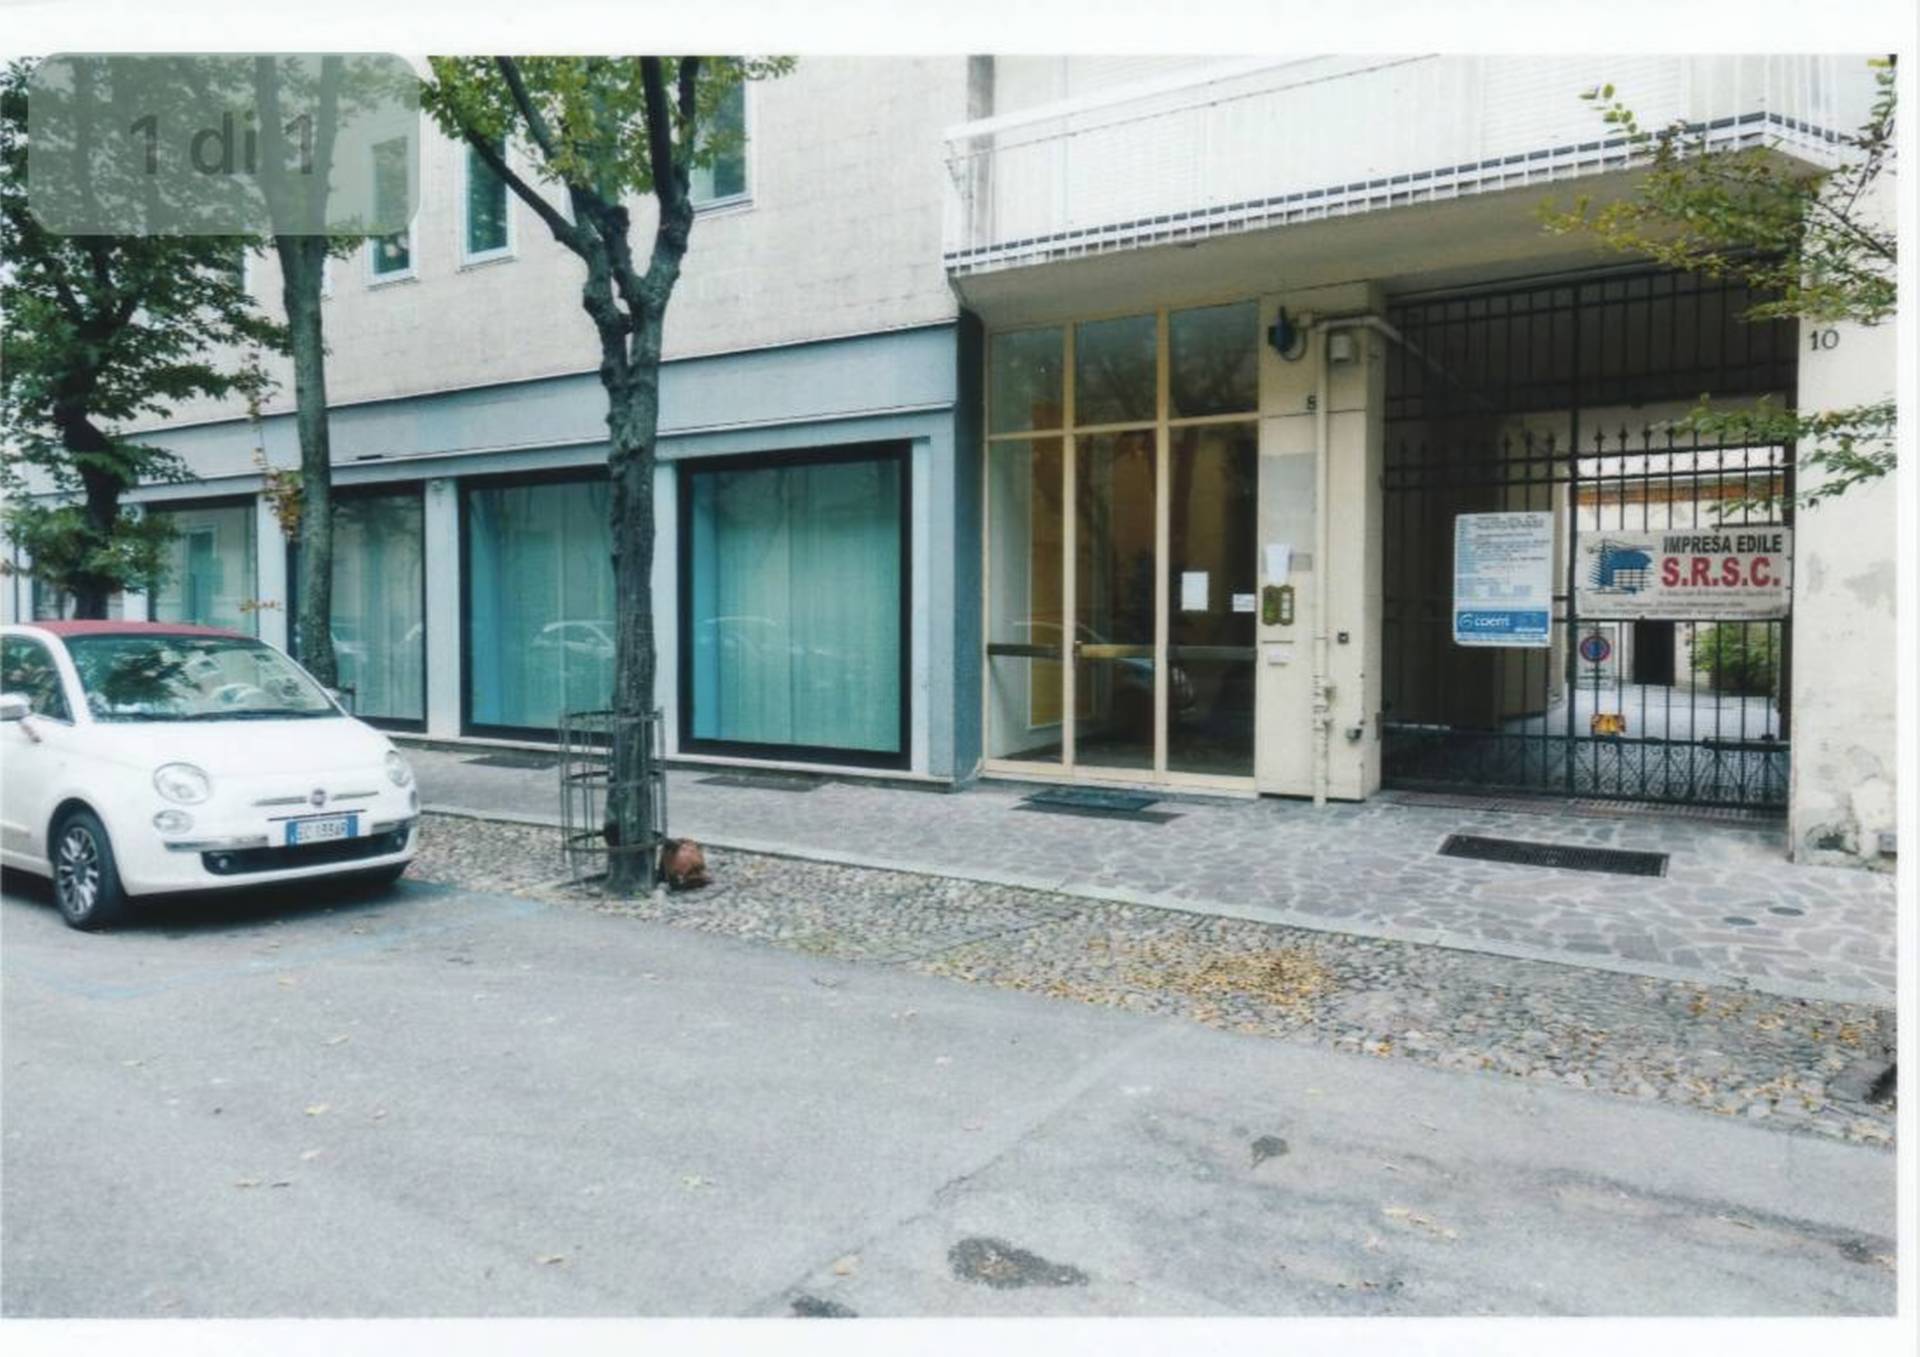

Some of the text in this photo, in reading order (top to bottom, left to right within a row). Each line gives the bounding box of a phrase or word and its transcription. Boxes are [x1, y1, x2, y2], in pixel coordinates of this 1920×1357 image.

[1810, 329, 1840, 351] 10
[1663, 533, 1783, 554] IMPRESA EDILE
[1661, 556, 1781, 587] S.R.S.C.
